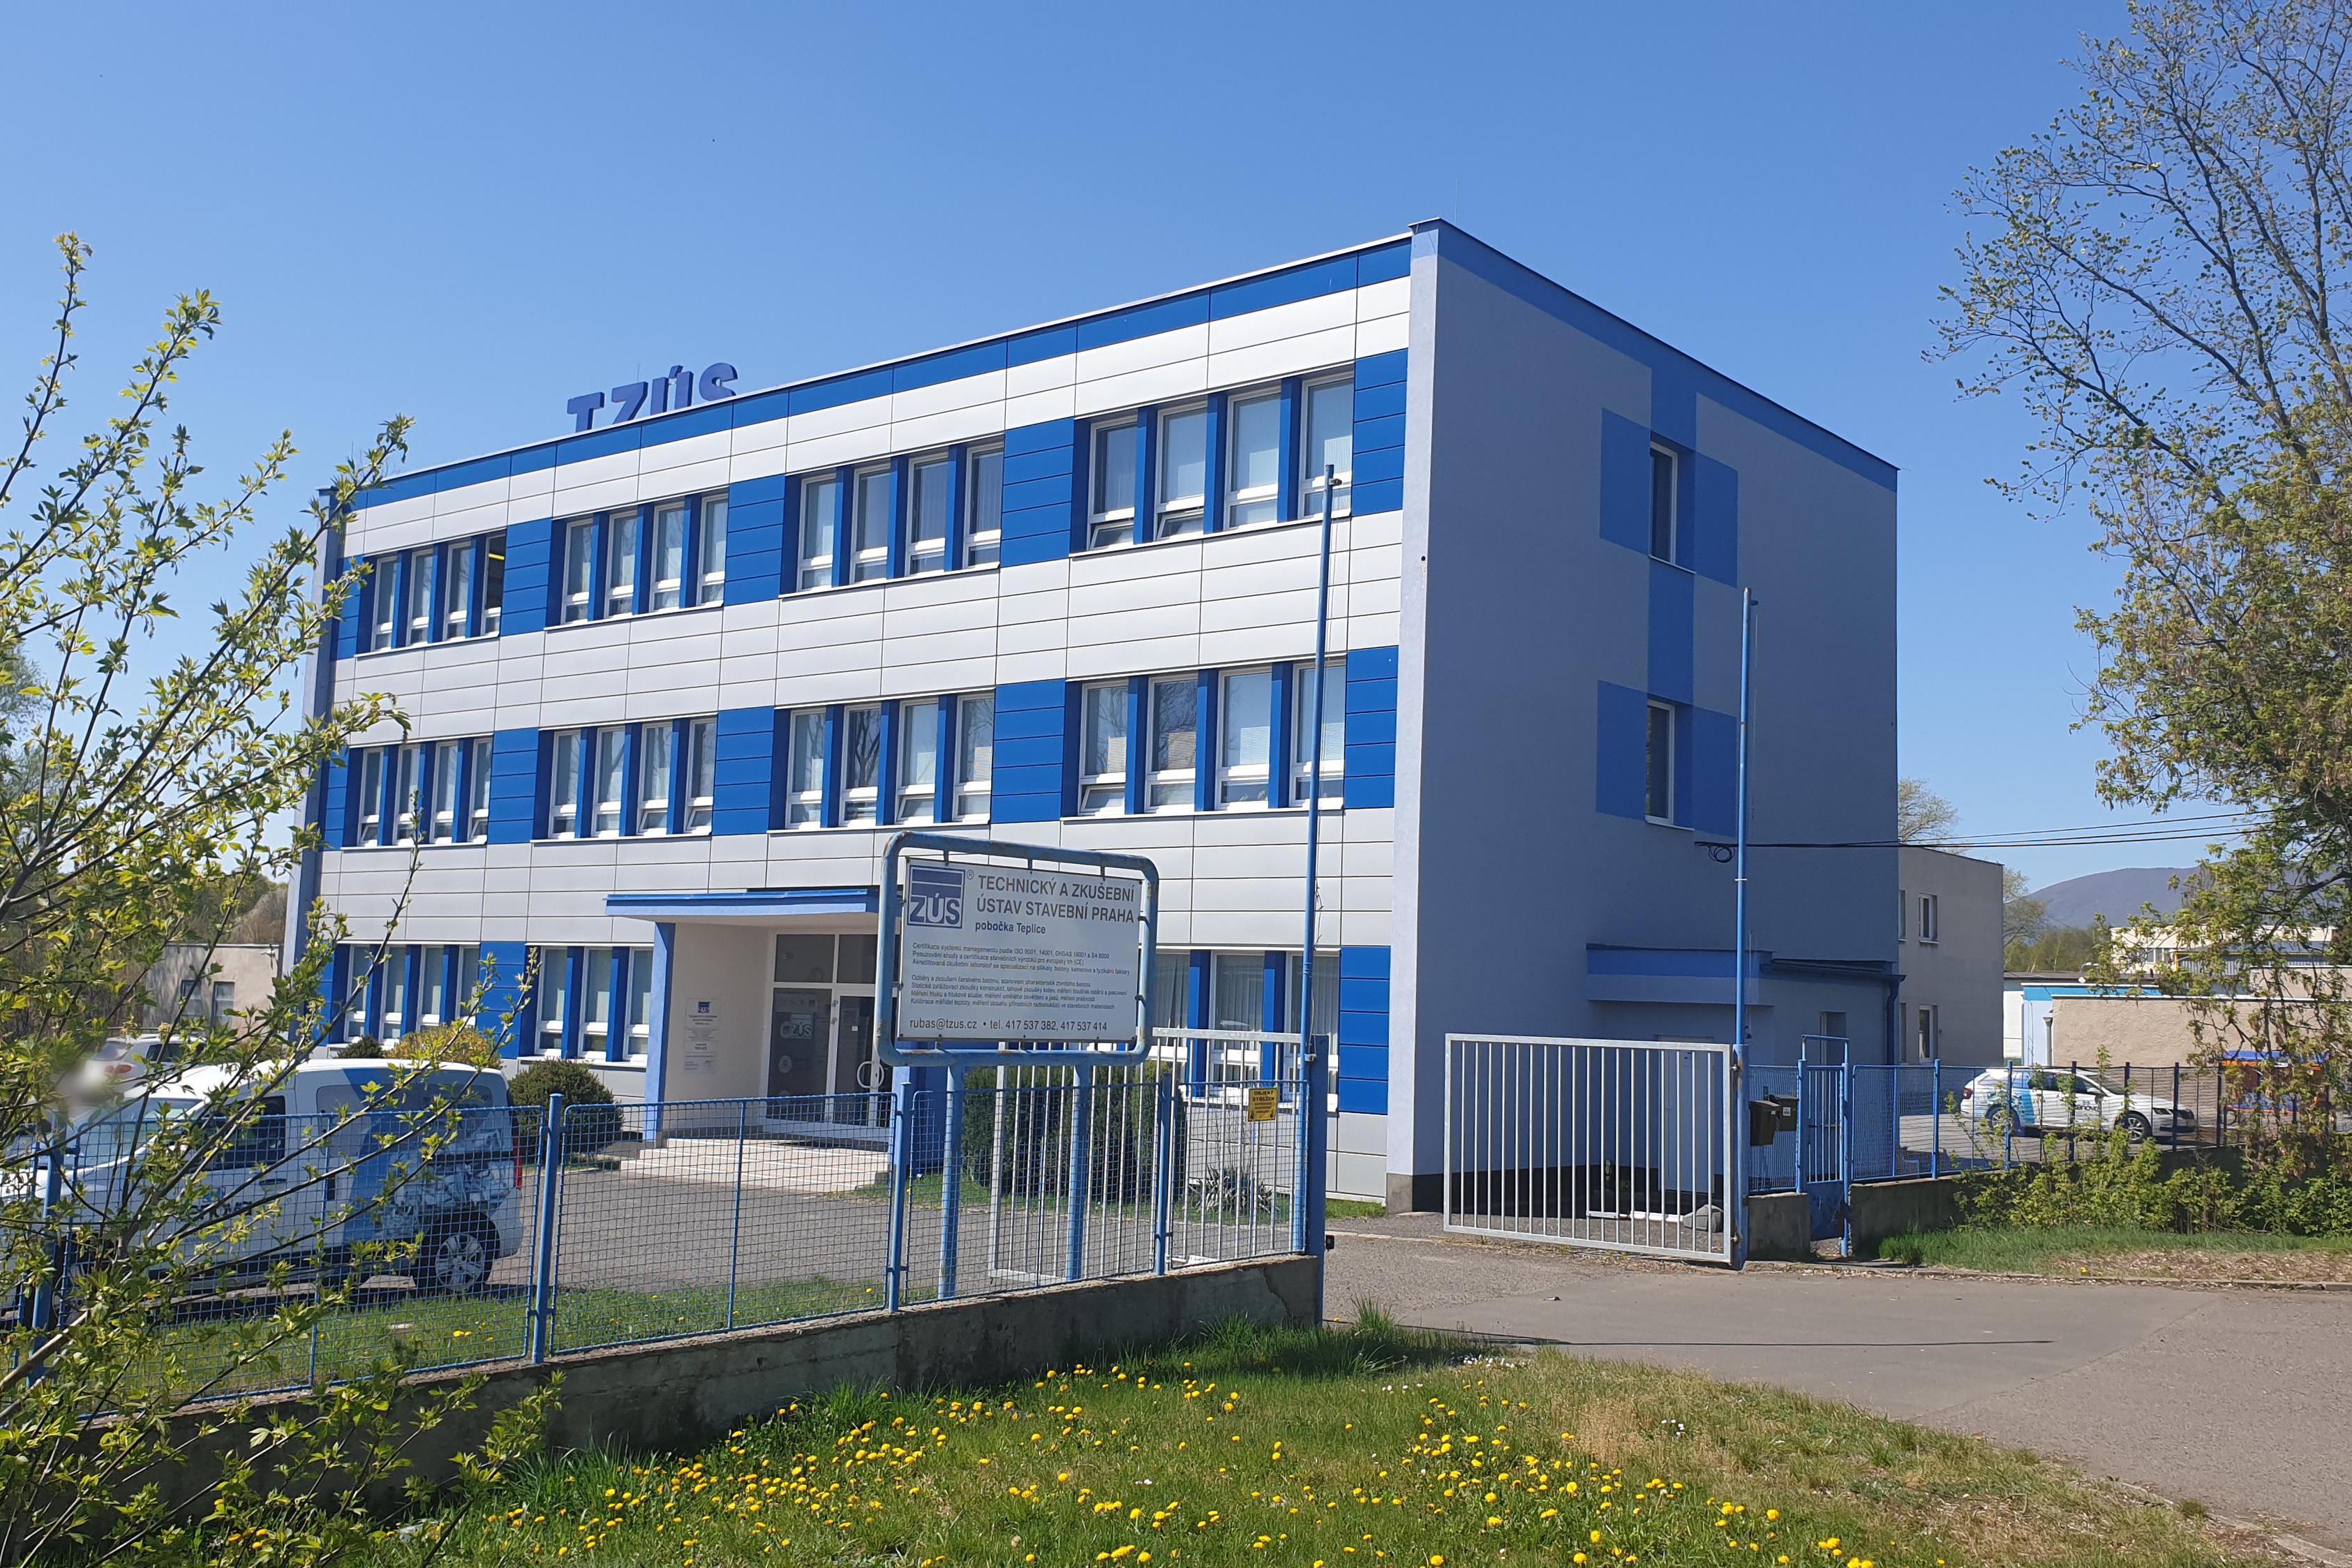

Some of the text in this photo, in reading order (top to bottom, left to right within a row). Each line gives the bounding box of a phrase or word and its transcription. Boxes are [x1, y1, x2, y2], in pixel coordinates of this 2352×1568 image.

[978, 875, 1135, 902] TECHNICKÝ A ZKUŠEBNÍ
[976, 893, 1134, 923] ÚSTAV STAVEBNÍ PRAHA
[975, 920, 1046, 935] pobočka Teplice
[909, 1018, 1107, 1031] rubas@tzus.cz tel. 417 537 382, 417 537 414
